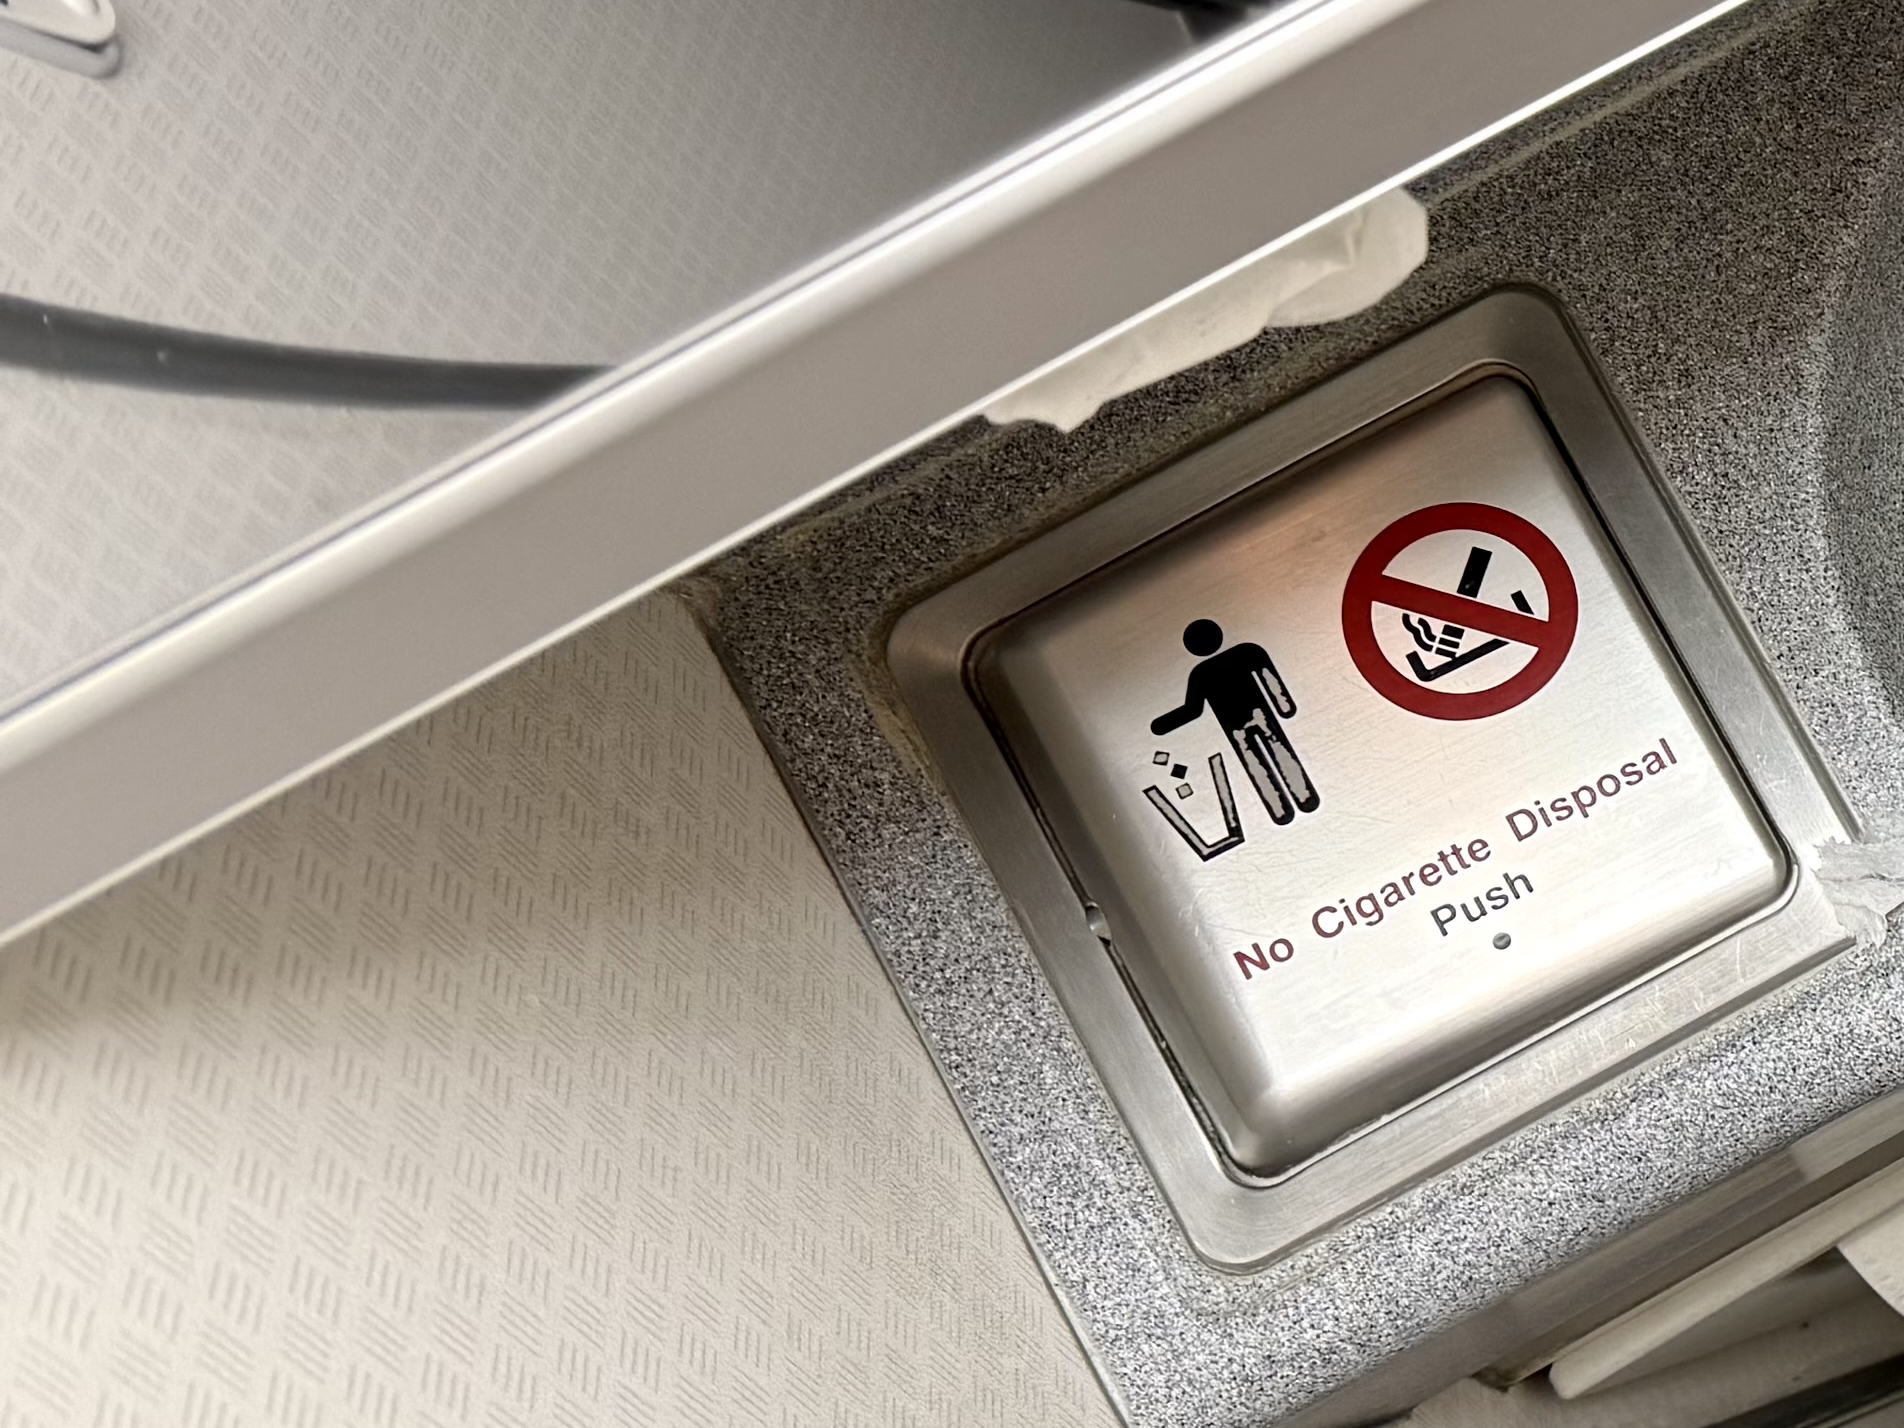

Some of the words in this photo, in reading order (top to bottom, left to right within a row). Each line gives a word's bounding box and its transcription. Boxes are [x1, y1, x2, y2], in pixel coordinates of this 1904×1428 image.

[1233, 938, 1294, 980] No
[1312, 838, 1491, 938] Cigarette
[1505, 737, 1677, 842] Disposal
[1430, 872, 1534, 937] Push
